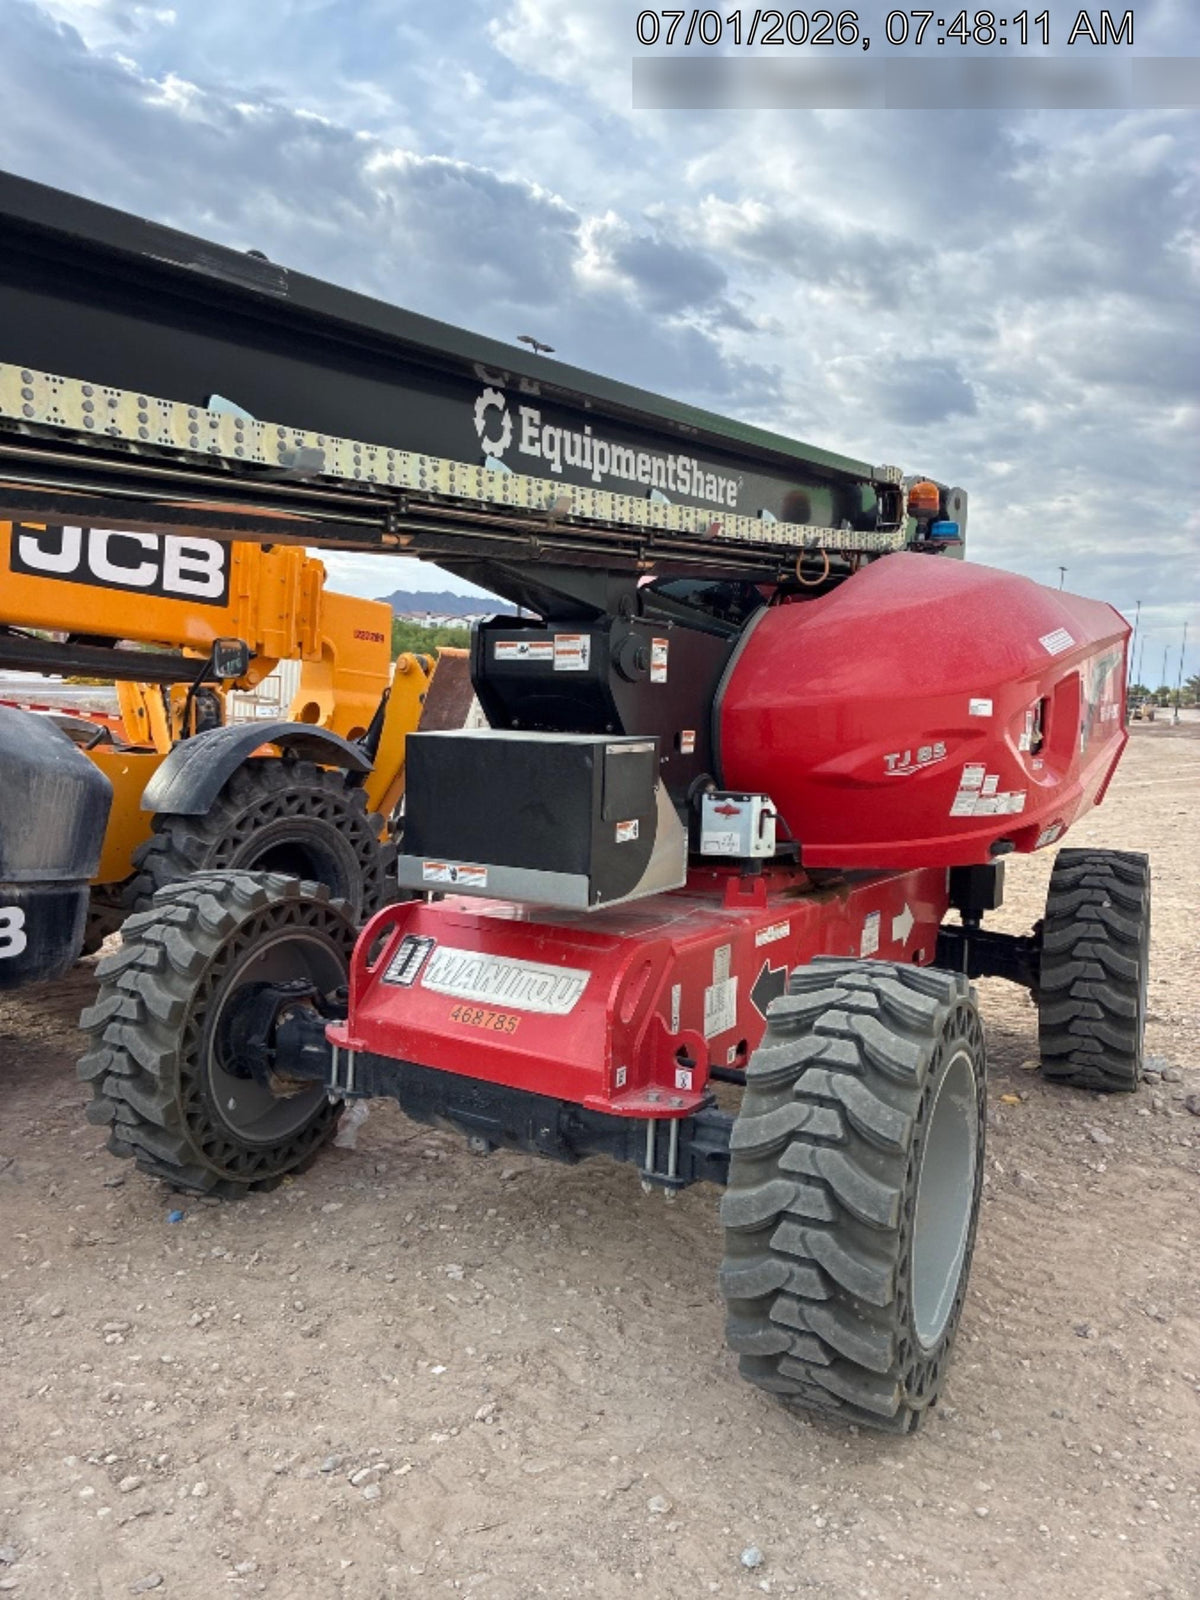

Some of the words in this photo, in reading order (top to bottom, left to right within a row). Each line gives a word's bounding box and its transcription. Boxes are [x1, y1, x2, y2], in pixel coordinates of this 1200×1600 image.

[518, 405, 738, 507] EquipmentShare
[18, 526, 226, 598] JCB
[883, 749, 912, 770] TJ
[424, 952, 584, 1007] MANITOU
[451, 1005, 518, 1033] 468785
